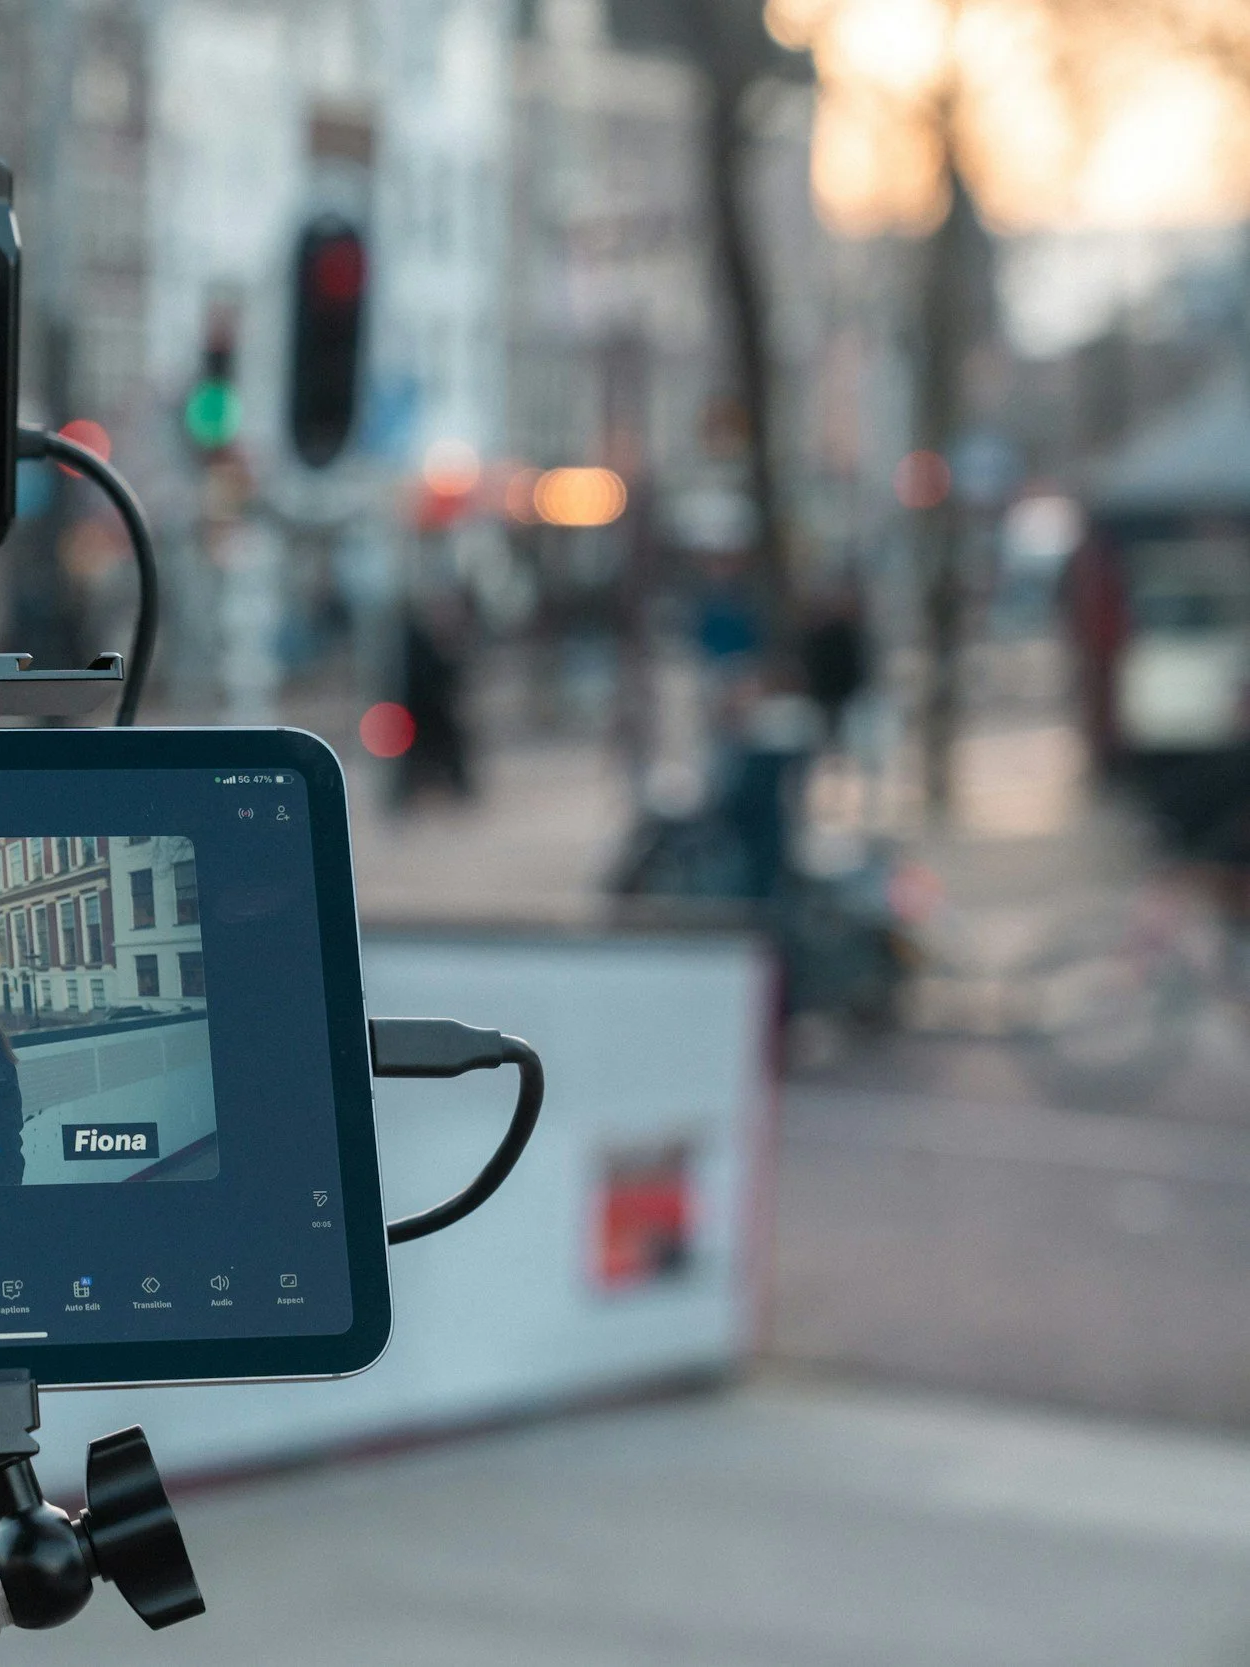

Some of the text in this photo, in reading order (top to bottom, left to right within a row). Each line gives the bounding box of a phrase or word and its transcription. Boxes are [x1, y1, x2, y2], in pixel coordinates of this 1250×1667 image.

[238, 775, 273, 784] 5G 47%
[74, 1128, 147, 1152] Fiona
[311, 1221, 332, 1229] 00:05
[132, 1300, 172, 1310] Transition
[210, 1298, 233, 1307] Audio
[276, 1296, 304, 1306] Aspect
[65, 1302, 101, 1312] Auto Edit
